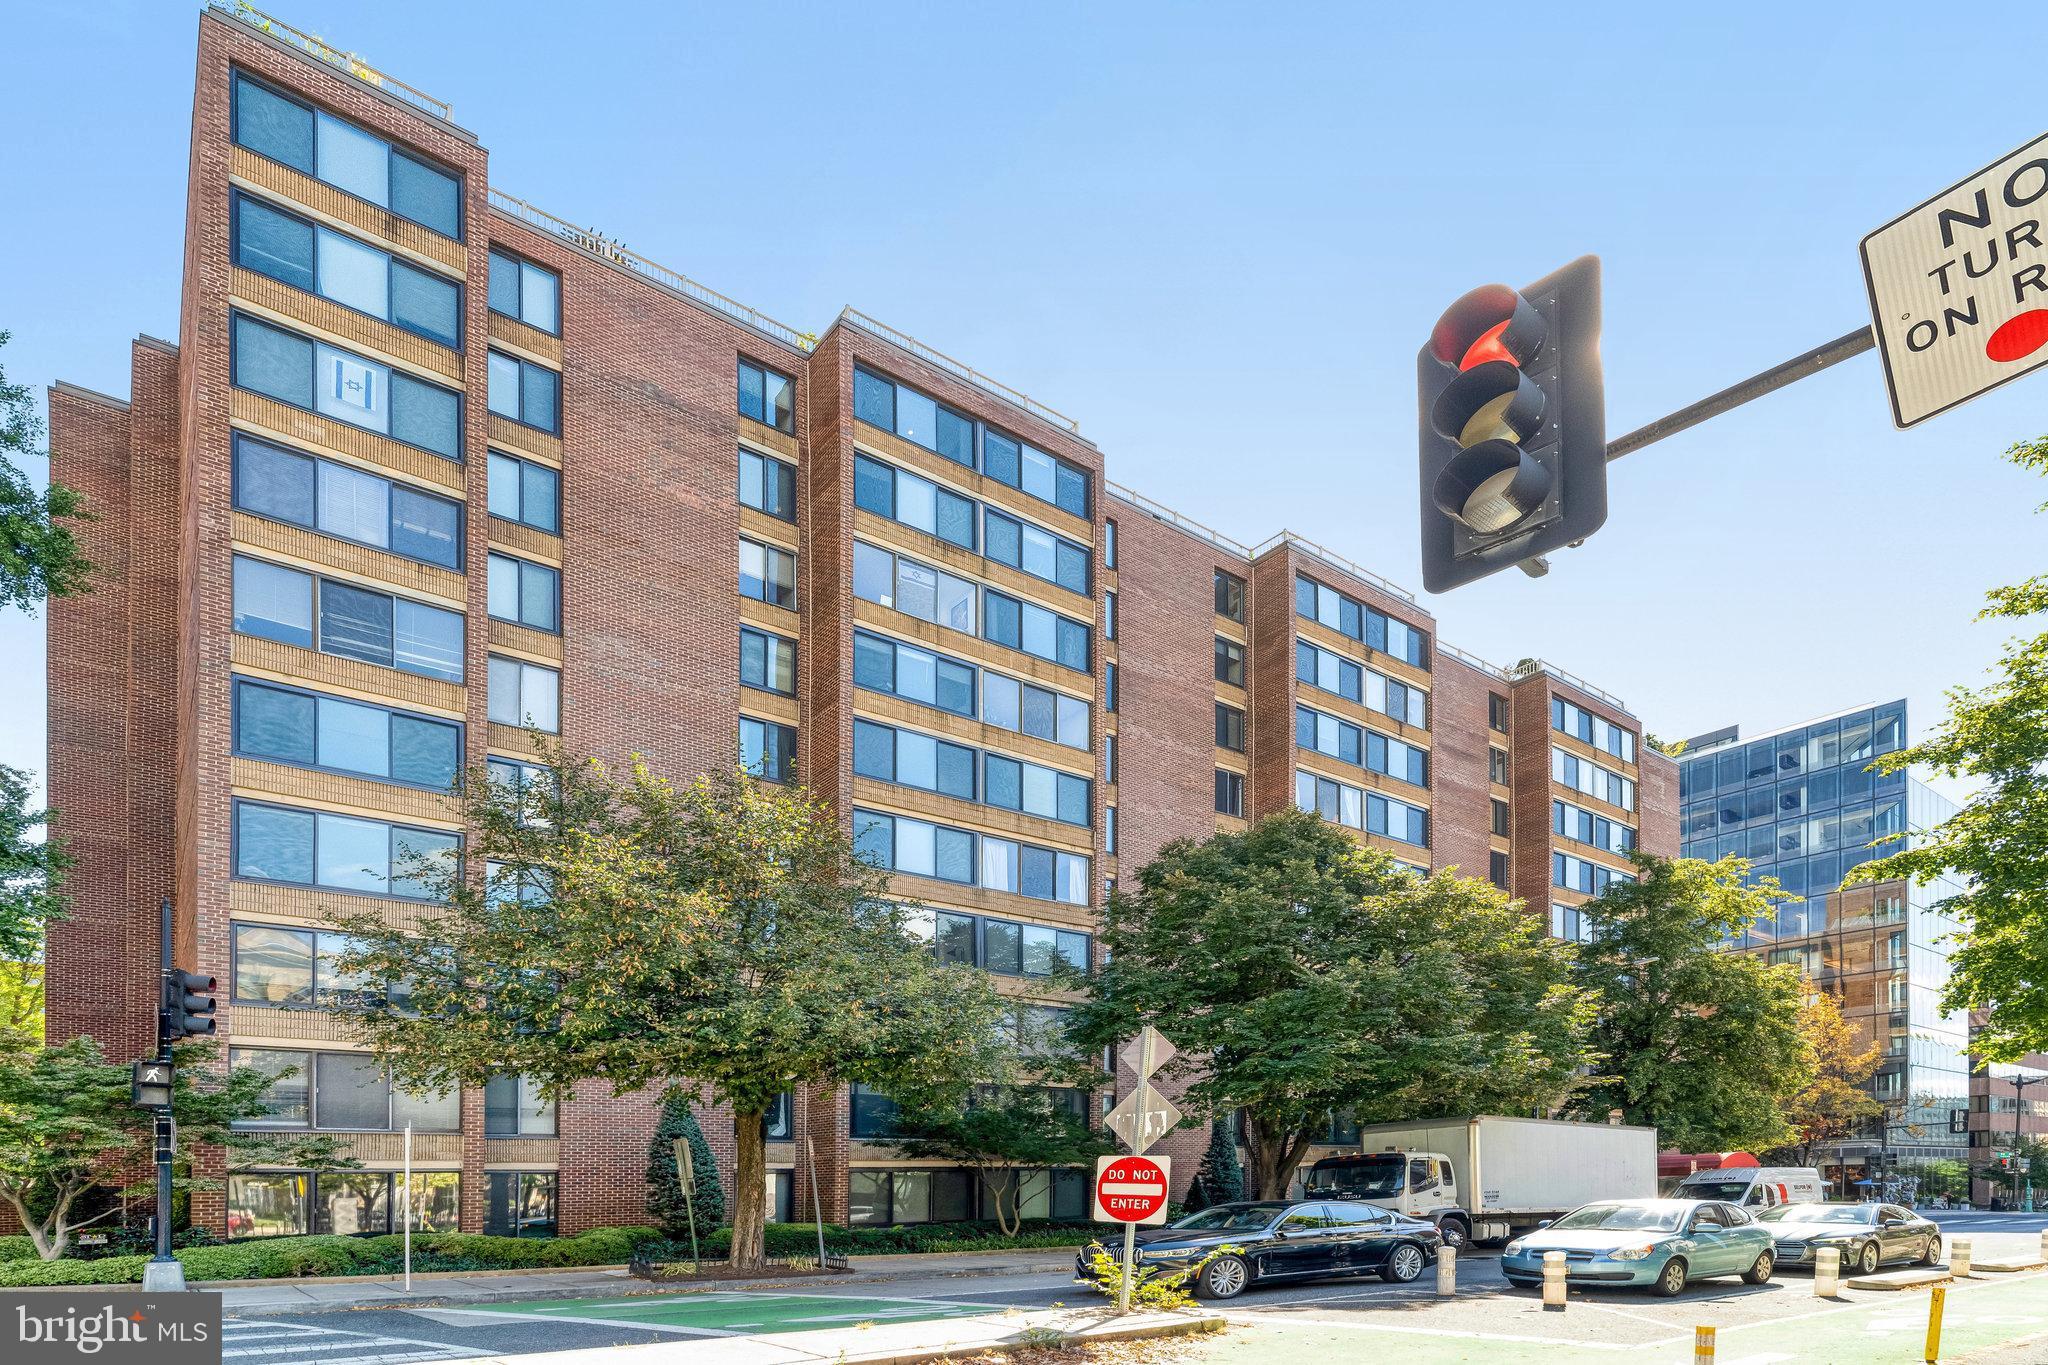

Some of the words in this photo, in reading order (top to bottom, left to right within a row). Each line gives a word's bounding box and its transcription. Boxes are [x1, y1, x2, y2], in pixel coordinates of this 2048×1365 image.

[1937, 157, 2048, 249] NO
[1906, 295, 1980, 353] ON
[1108, 1169, 1126, 1181] DO
[1132, 1170, 1158, 1181] NOT
[1110, 1198, 1151, 1210] ENTER
